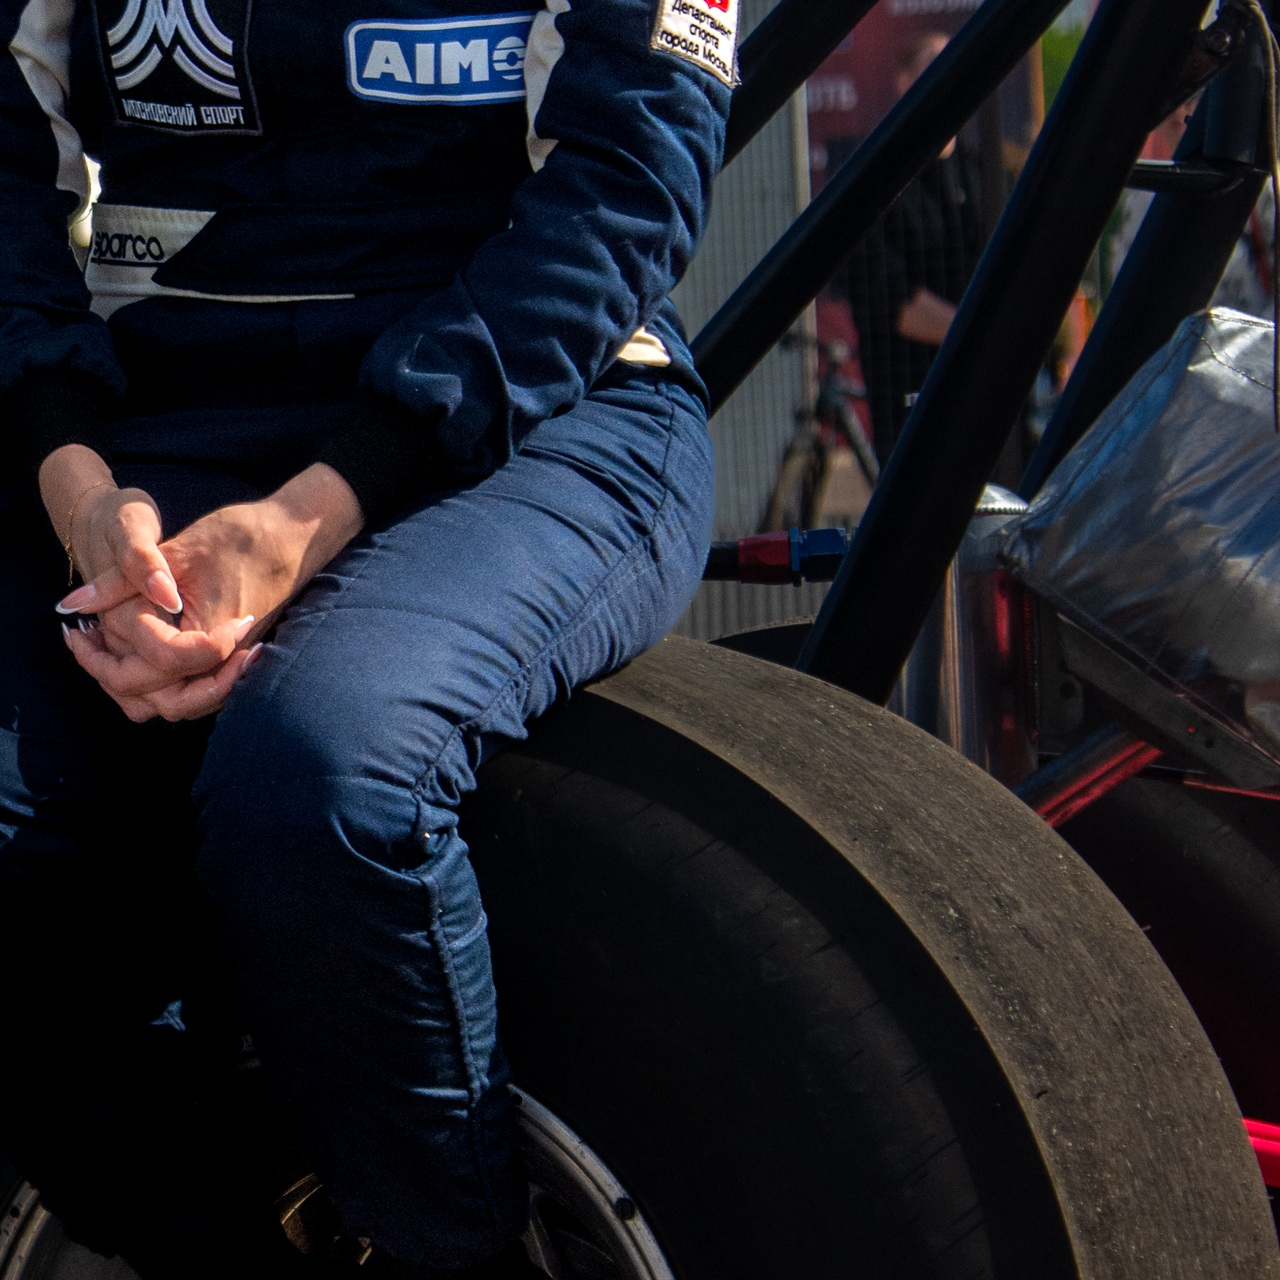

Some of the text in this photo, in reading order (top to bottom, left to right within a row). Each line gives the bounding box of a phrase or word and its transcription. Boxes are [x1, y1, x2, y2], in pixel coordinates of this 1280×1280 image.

[659, 30, 700, 56] города
[690, 23, 719, 50] спорта
[362, 36, 526, 86] AIMO
[121, 98, 245, 126] МОСКОВСКИЙ СПОРТ
